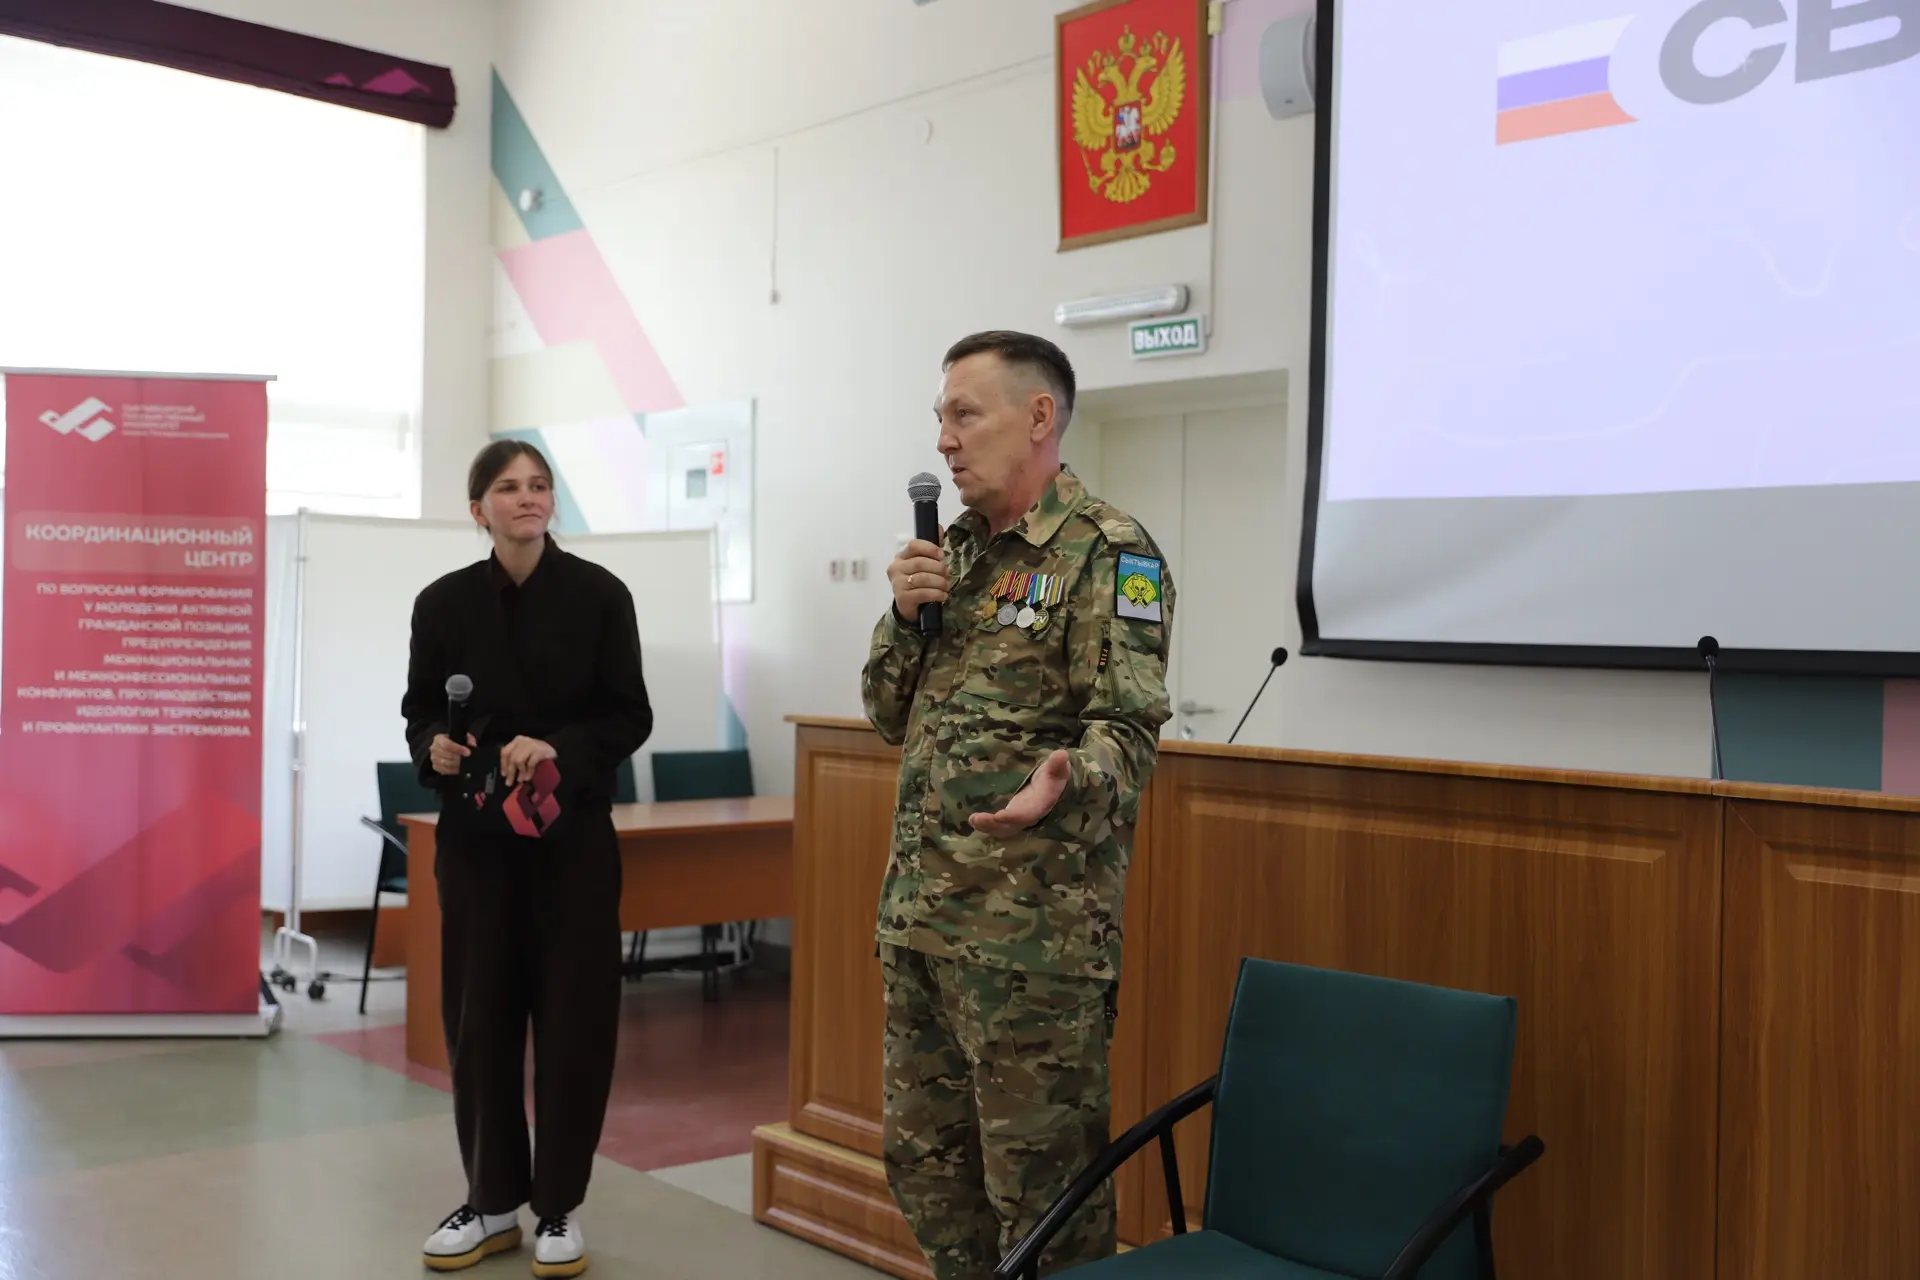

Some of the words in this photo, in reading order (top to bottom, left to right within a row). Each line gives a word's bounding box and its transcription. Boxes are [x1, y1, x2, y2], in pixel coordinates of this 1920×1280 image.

[1134, 323, 1196, 350] ВЫХОД
[25, 524, 253, 545] КООРДИНАЦИОННЫЙ
[184, 551, 253, 567] ЦЕНТР
[36, 583, 57, 595] ПО
[60, 584, 136, 596] ВОПРОСАМ
[138, 585, 253, 599] ФОРМИРОВАНИЯ
[181, 603, 252, 616] АКТИВНОЙ
[78, 618, 181, 632] ГРАЖДАНСКОЙ
[122, 636, 252, 651] ПРЕДУПРЕЖДЕНИЯ
[103, 654, 251, 668] МЕЖНАЦИОНАЛЬНЫХ
[54, 670, 66, 681] И
[68, 670, 251, 685] МЕЖКОНФЕССИОНАЛЬНЫХ
[118, 687, 252, 702] ПРОТИВОДЕЙСТВИЯ
[76, 705, 159, 718] ИДЕОЛОГИИ
[162, 706, 251, 720] ТЕРРОРИЗМА
[22, 721, 34, 733] И
[35, 721, 149, 734] ПРОФИЛАКТИКИ
[151, 723, 251, 736] ЭКСТРЕМИЗМА
